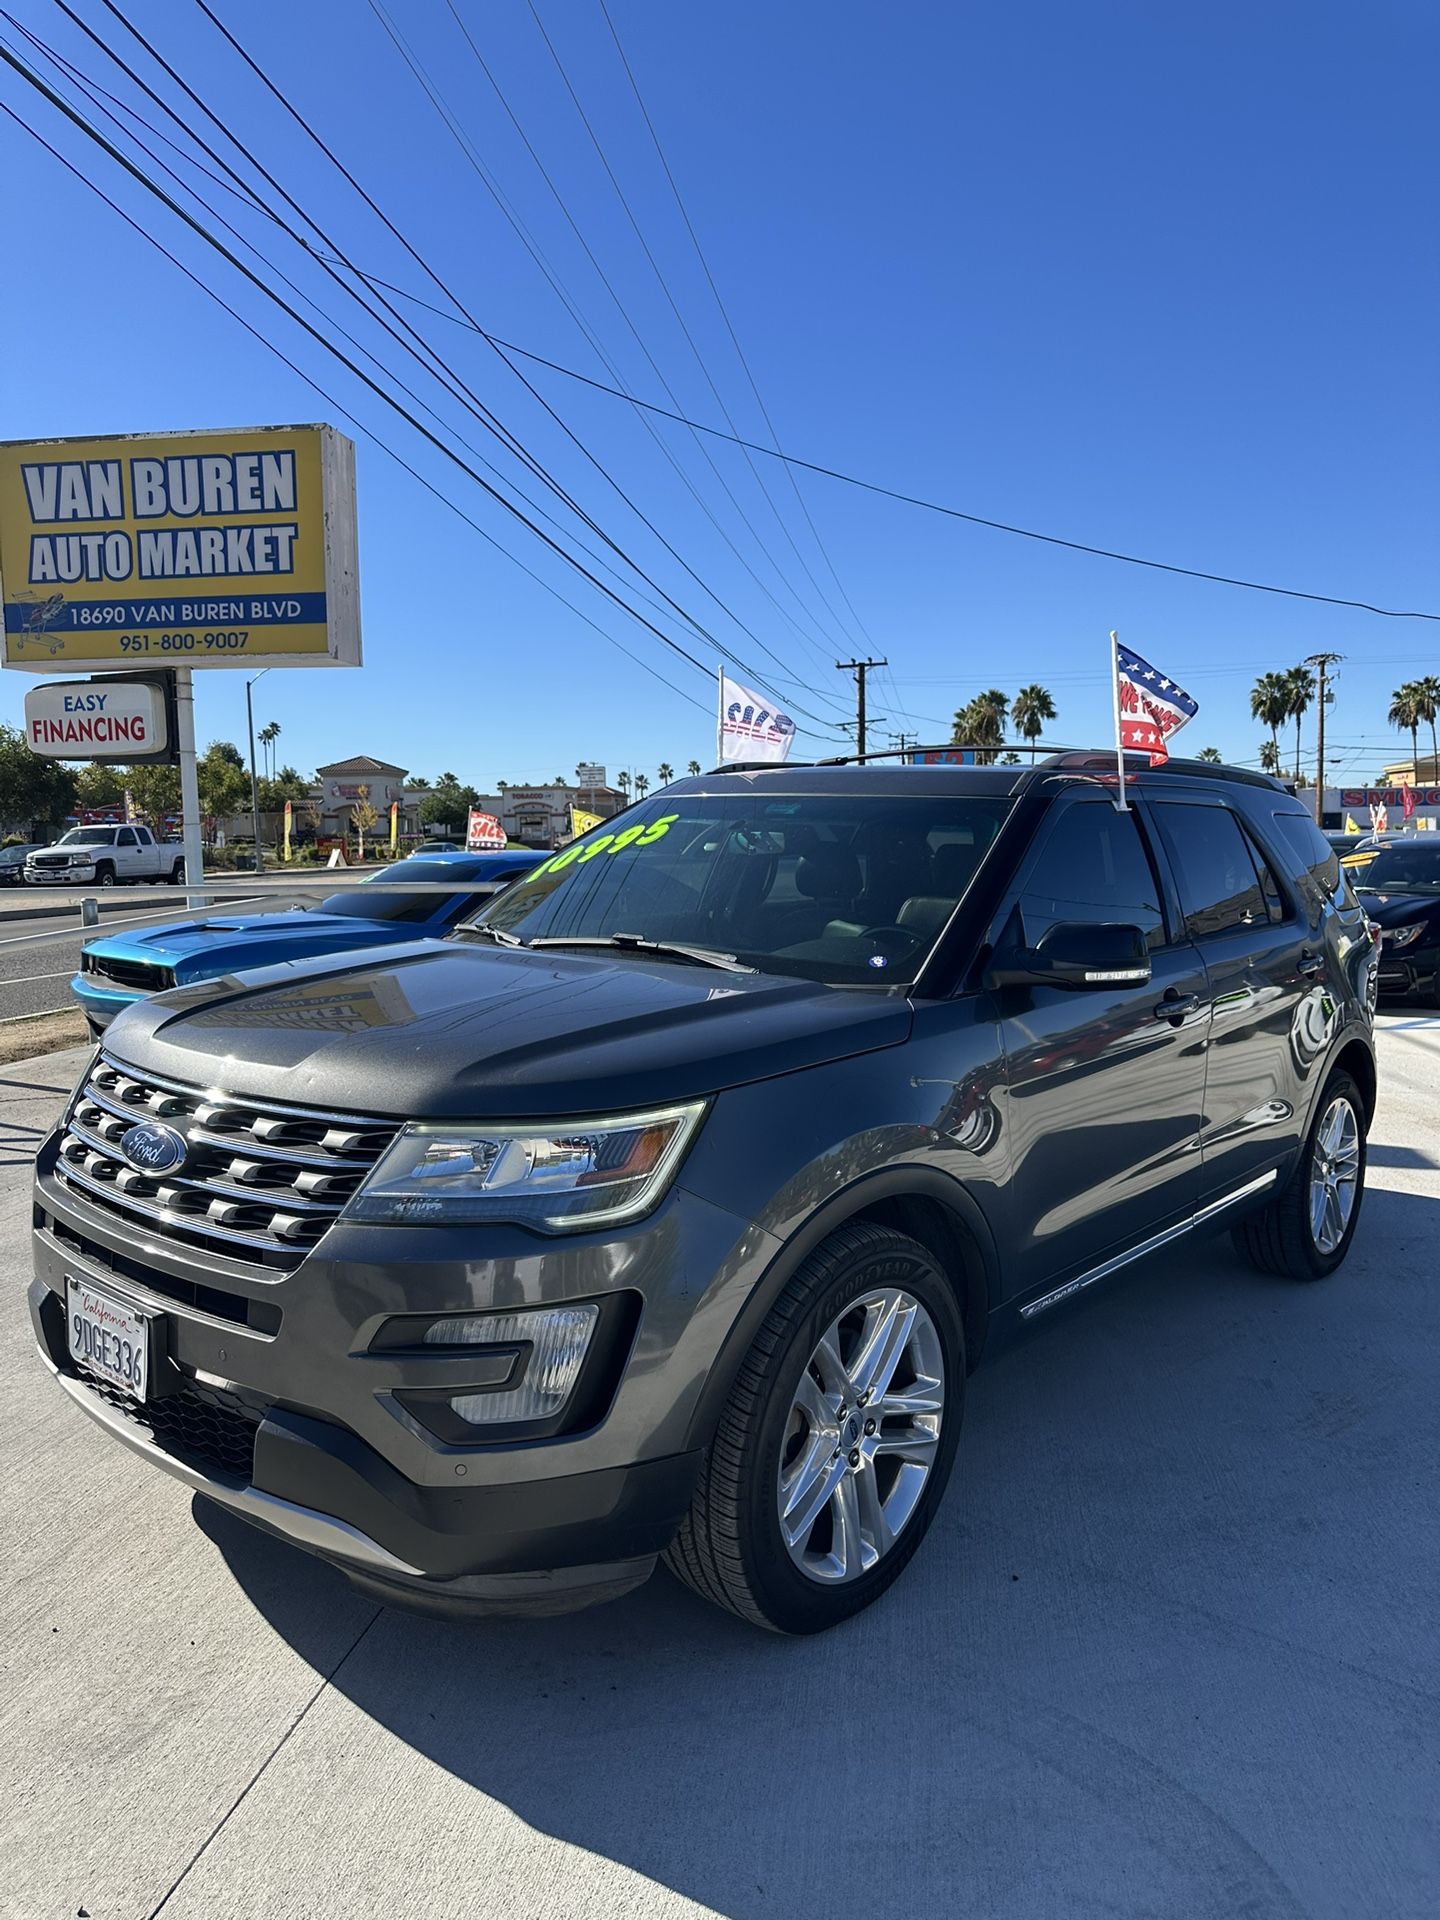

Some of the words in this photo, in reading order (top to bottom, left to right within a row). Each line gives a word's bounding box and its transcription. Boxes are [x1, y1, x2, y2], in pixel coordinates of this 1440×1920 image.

[22, 460, 124, 522] VAN
[131, 451, 296, 518] BUREN
[29, 531, 132, 583] AUTO
[138, 523, 298, 579] MARKET
[70, 606, 126, 625] 18690
[131, 604, 175, 623] VAN
[181, 602, 245, 621] BUREN
[251, 600, 301, 619] BLVD
[119, 631, 250, 651] 951-800-9007
[63, 694, 108, 712] EASY
[1119, 680, 1138, 713] WE
[32, 715, 146, 743] FINANCING
[722, 702, 794, 746] SALE
[470, 821, 505, 839] SALE
[526, 814, 680, 883] 10995
[127, 1130, 165, 1164] Ford
[83, 1295, 132, 1334] California
[73, 1313, 142, 1387] 9DGE336
